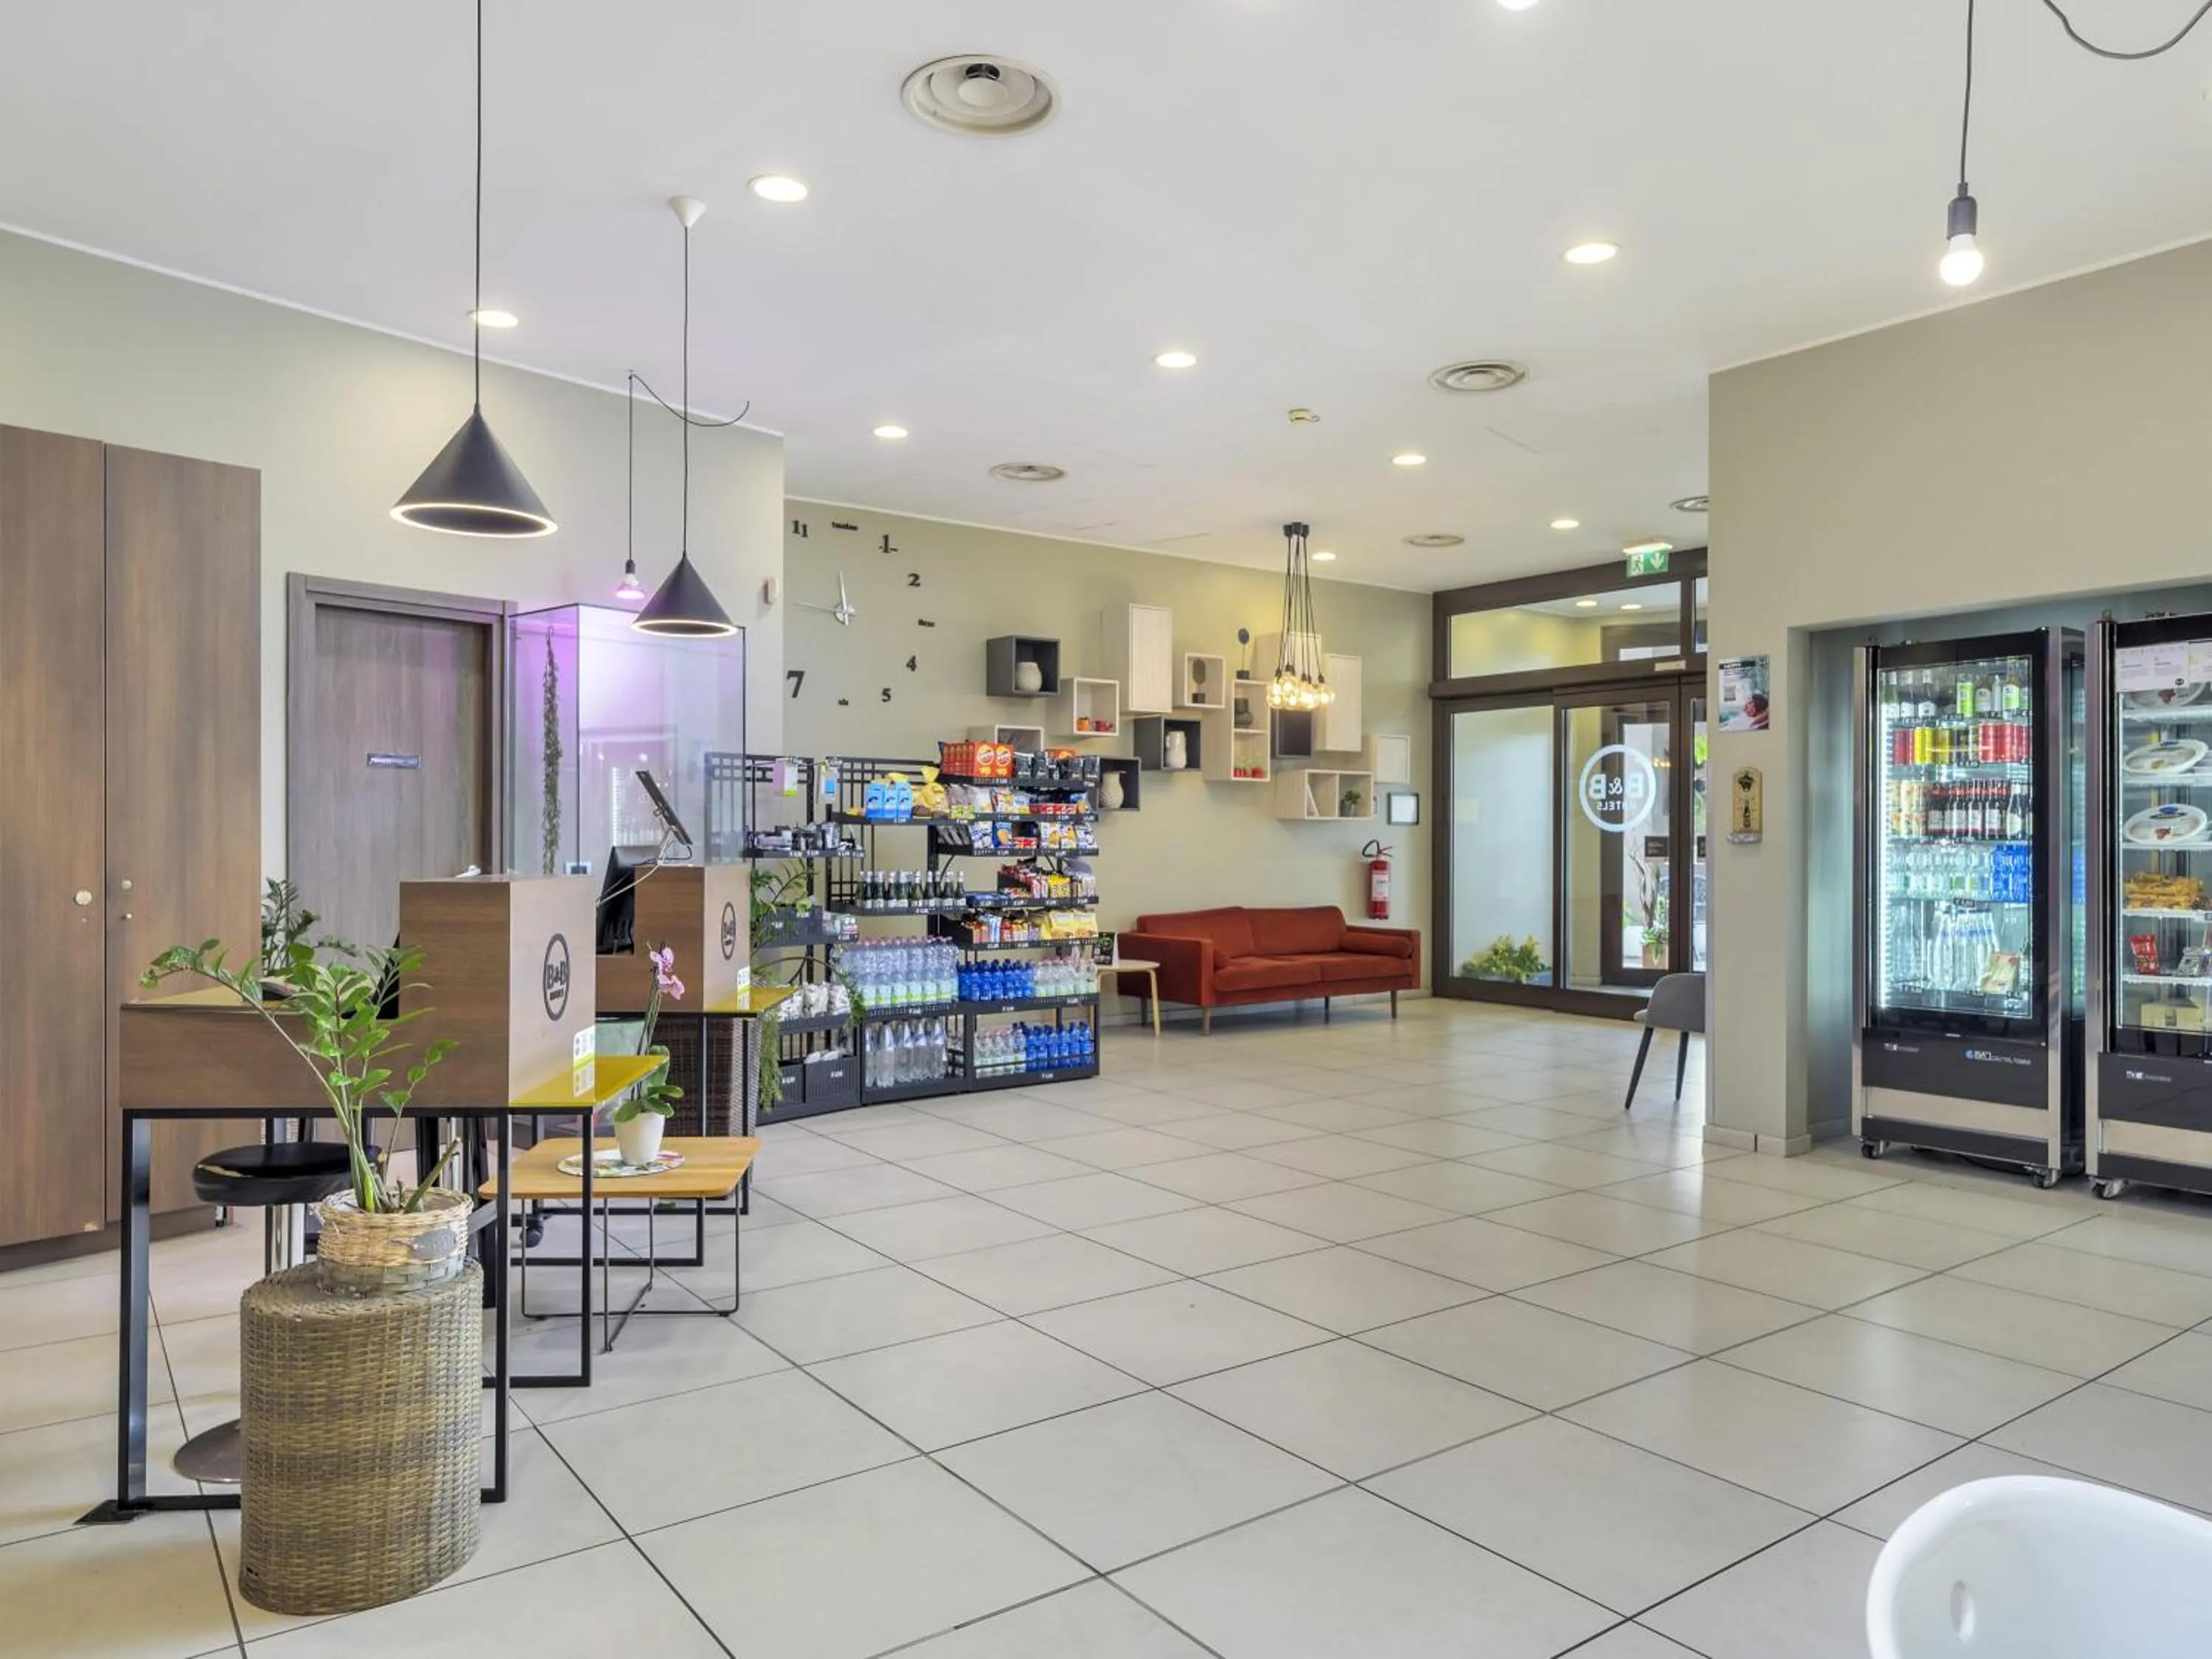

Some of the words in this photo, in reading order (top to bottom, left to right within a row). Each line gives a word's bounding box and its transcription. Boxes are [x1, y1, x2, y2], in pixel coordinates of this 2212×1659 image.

[792, 520, 808, 538] 11
[908, 573, 921, 587] 2
[906, 655, 917, 672] 4
[787, 670, 805, 698] 7
[881, 688, 891, 703] 5
